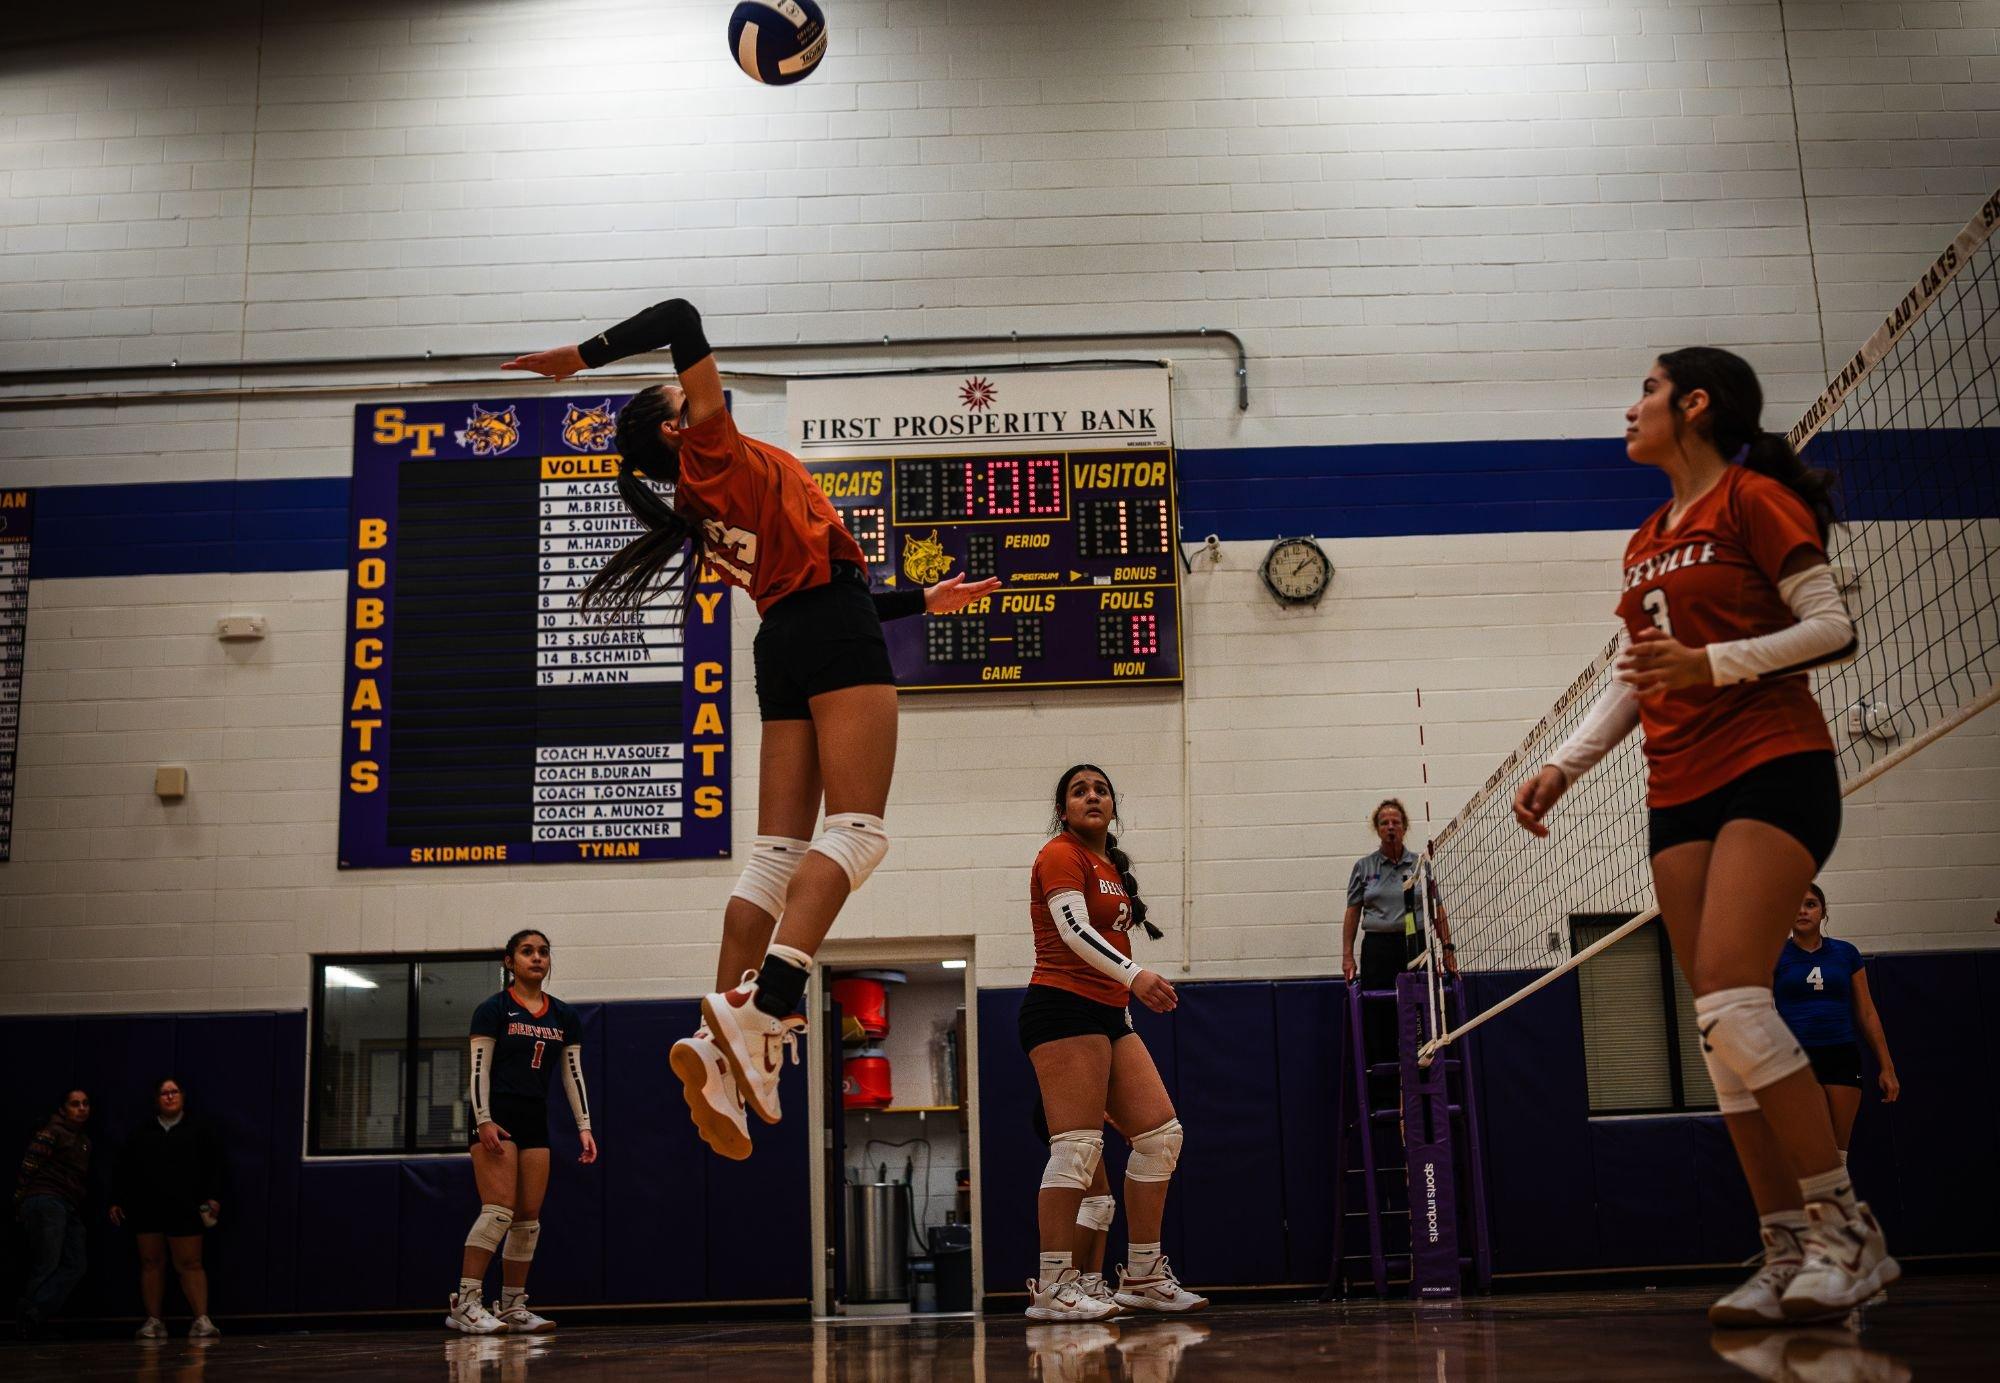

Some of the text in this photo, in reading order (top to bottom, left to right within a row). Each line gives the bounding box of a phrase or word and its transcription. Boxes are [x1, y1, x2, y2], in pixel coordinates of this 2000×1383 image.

[1886, 243, 1957, 339] LADY CATS
[802, 408, 1157, 441] FIRST PROSPERITY BANK
[549, 458, 624, 475] VOLLEY
[1073, 460, 1167, 490] VISITOR
[544, 486, 549, 495] 1
[544, 503, 551, 514] 3
[544, 522, 551, 532] 4
[544, 541, 551, 551] 5
[1004, 532, 1051, 549] PERIOD
[543, 559, 551, 570] 6
[1114, 566, 1157, 582] BONUS
[544, 578, 550, 589] 7
[542, 597, 549, 607] 8
[1001, 594, 1056, 613] FOULS
[1100, 591, 1155, 611] FOULS
[543, 616, 556, 627] 10
[544, 632, 646, 645] 12 S.SUGAREK
[1131, 615, 1158, 654] 0
[349, 518, 388, 794] BOBCATS
[544, 650, 649, 665] 14 B.SCHMIDT
[542, 670, 629, 684] 15 J.MANN
[981, 665, 1023, 681] GAME
[1113, 661, 1146, 677] WON
[540, 746, 670, 761] COACH H.VASQUEZ
[539, 766, 651, 780] COACH B.DURAN
[539, 784, 677, 800] COACH T.GONZALES
[539, 806, 586, 819] COACH
[611, 804, 665, 817] MUNOZ
[538, 823, 670, 839] COACH E.BUCKNER
[410, 845, 507, 864] SKIDMORE
[577, 841, 640, 859] TYNAN
[1806, 966, 1824, 991] 4
[531, 1040, 546, 1069] 1
[1424, 1162, 1440, 1243] sports imports
